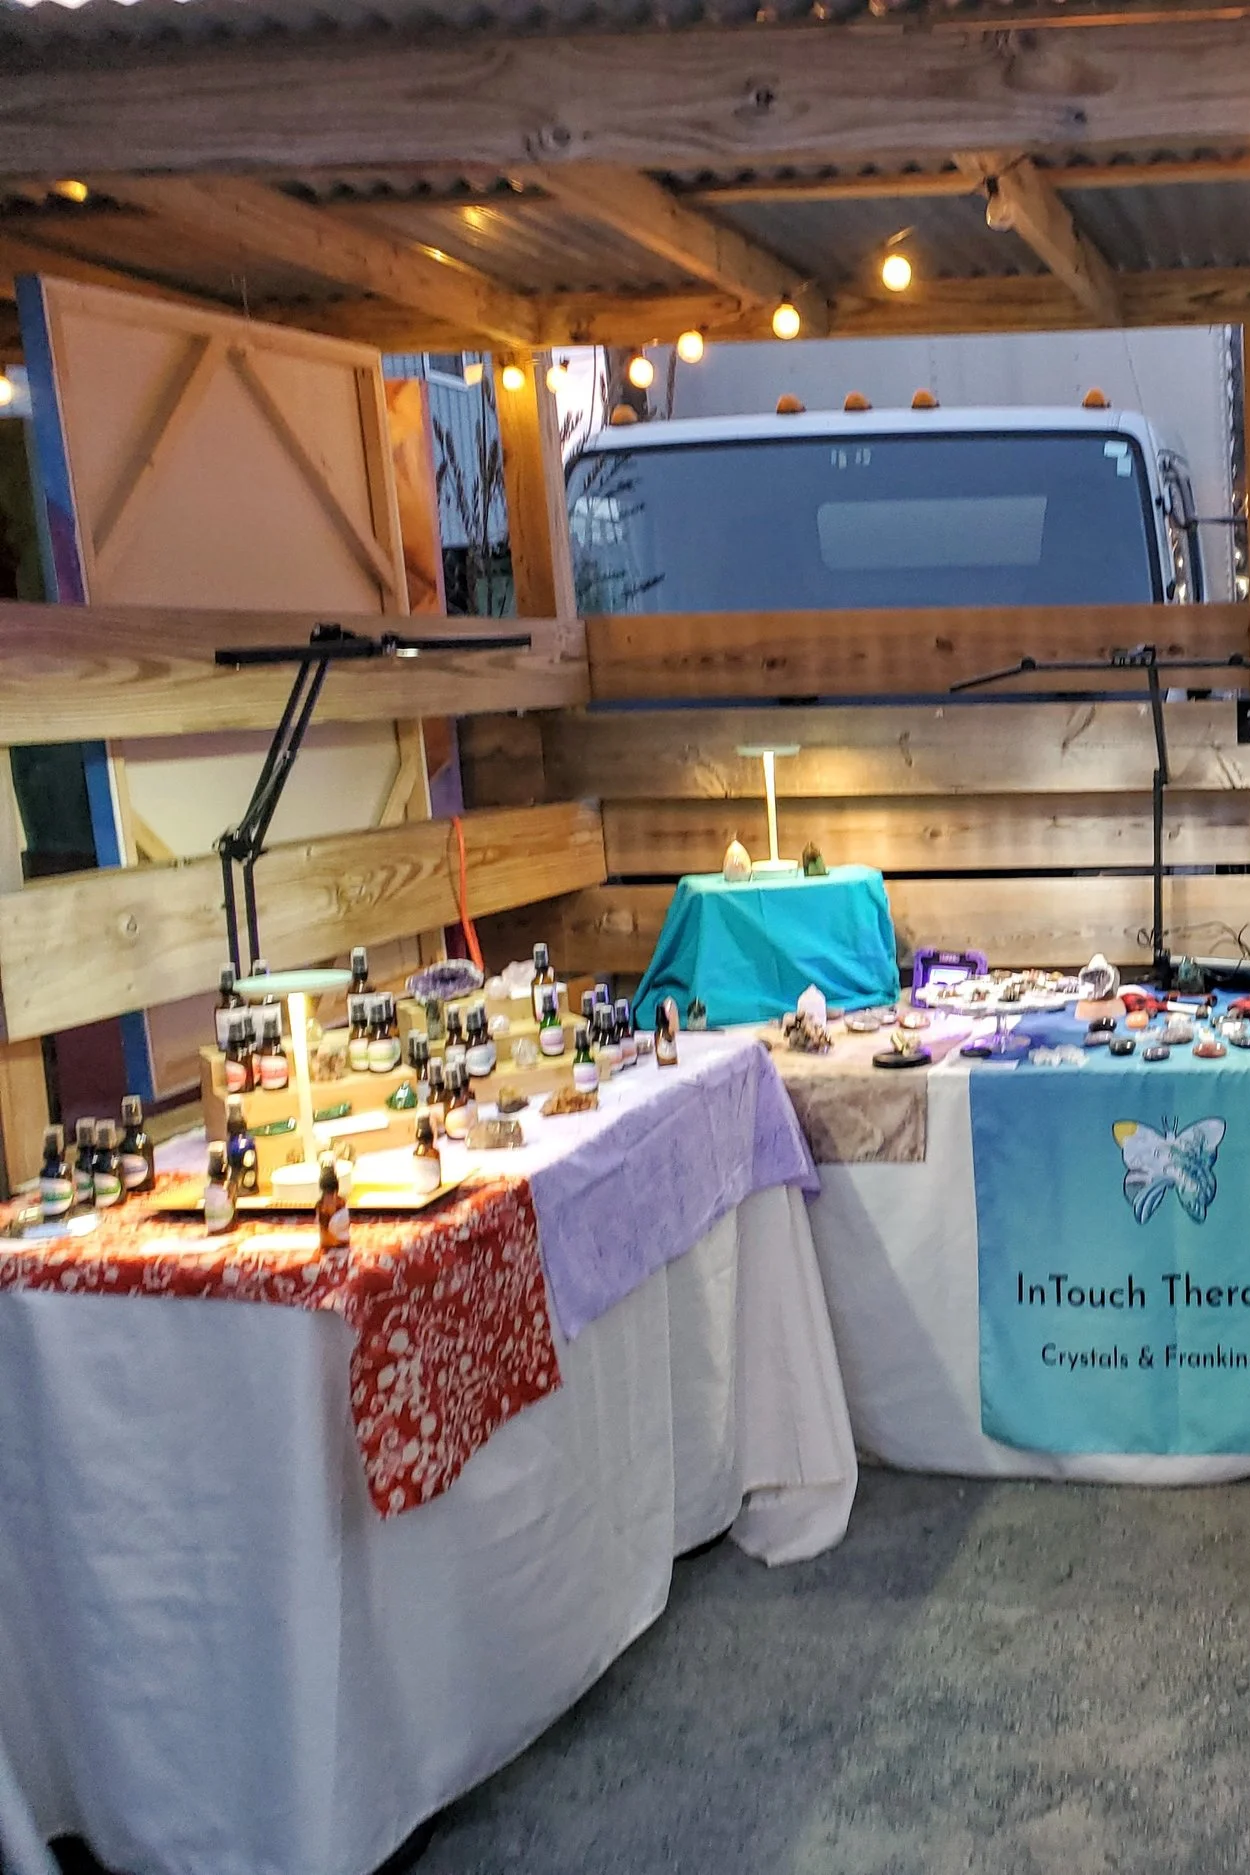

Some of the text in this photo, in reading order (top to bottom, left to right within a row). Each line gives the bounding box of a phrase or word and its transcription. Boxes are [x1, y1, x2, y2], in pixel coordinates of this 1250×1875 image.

[1015, 1271, 1146, 1309] InTouch
[1041, 1342, 1129, 1372] Crystals
[1138, 1345, 1155, 1370] &
